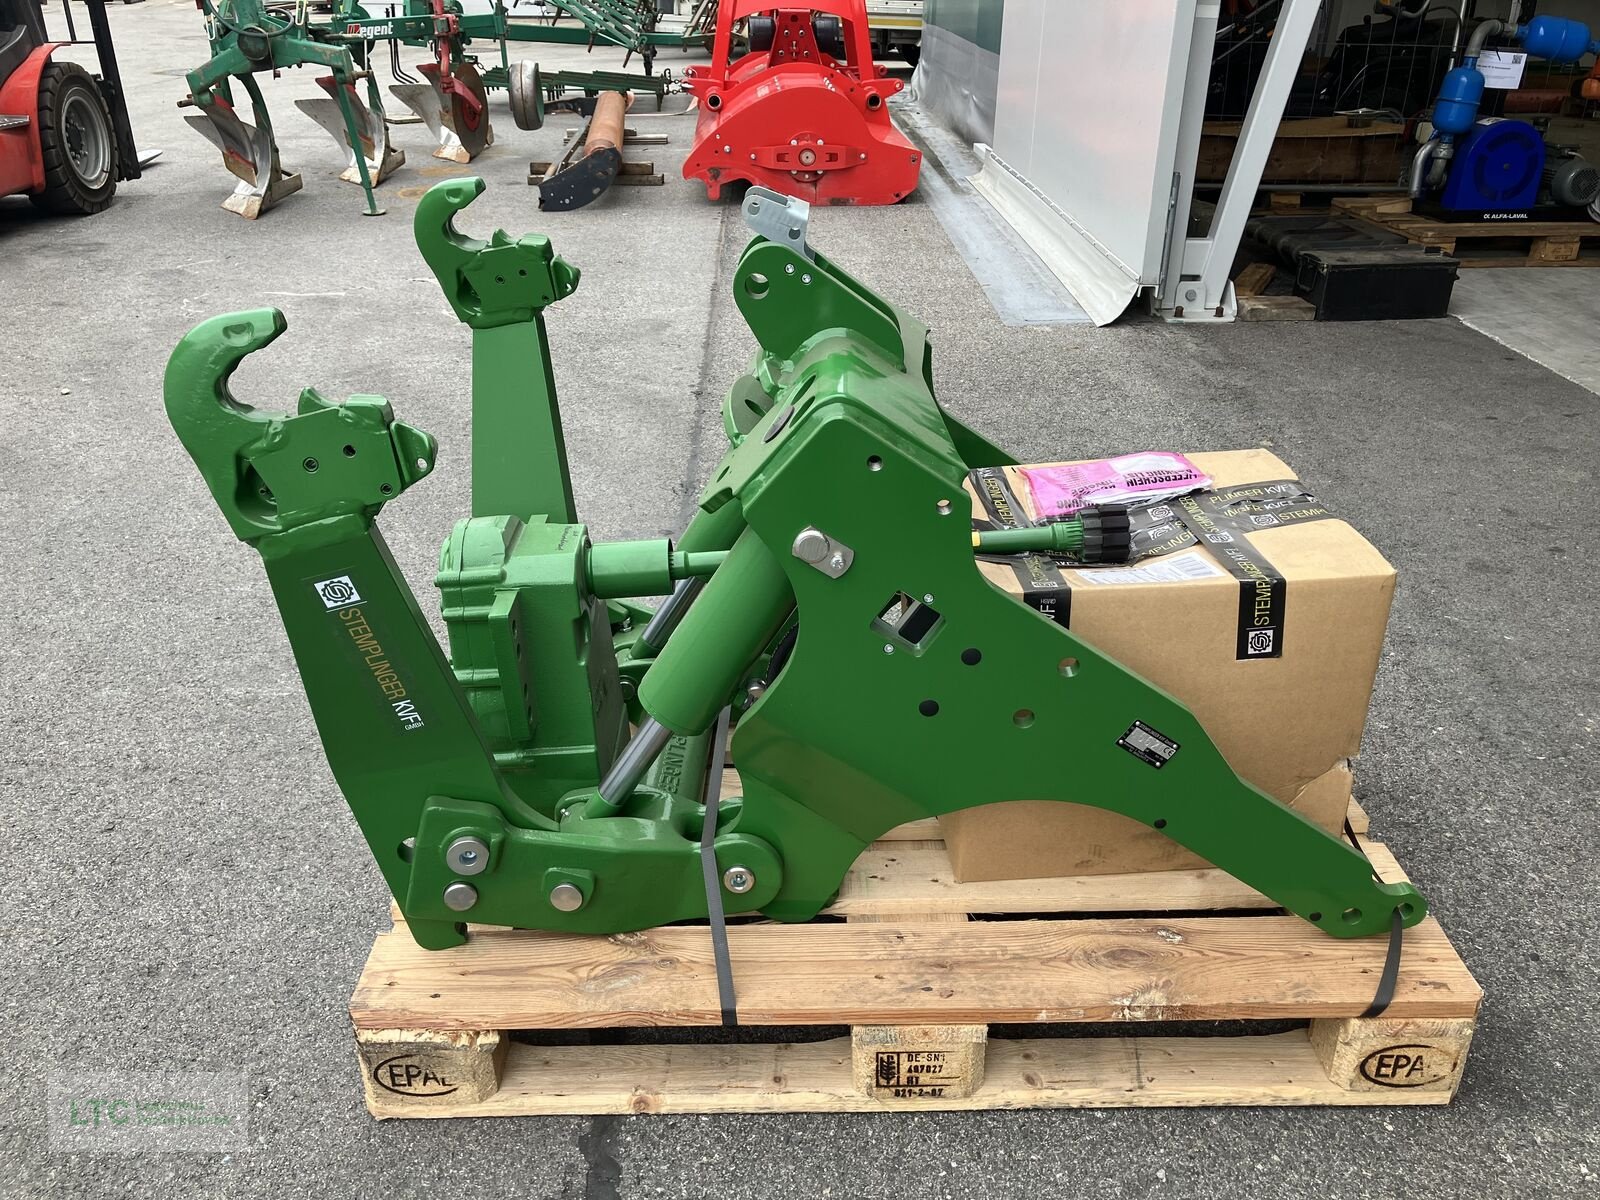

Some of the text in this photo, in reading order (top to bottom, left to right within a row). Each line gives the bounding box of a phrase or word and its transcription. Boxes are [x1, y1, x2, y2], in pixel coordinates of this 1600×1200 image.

[338, 607, 423, 724] STEMPLINGER KVF
[403, 721, 425, 731] GMBH
